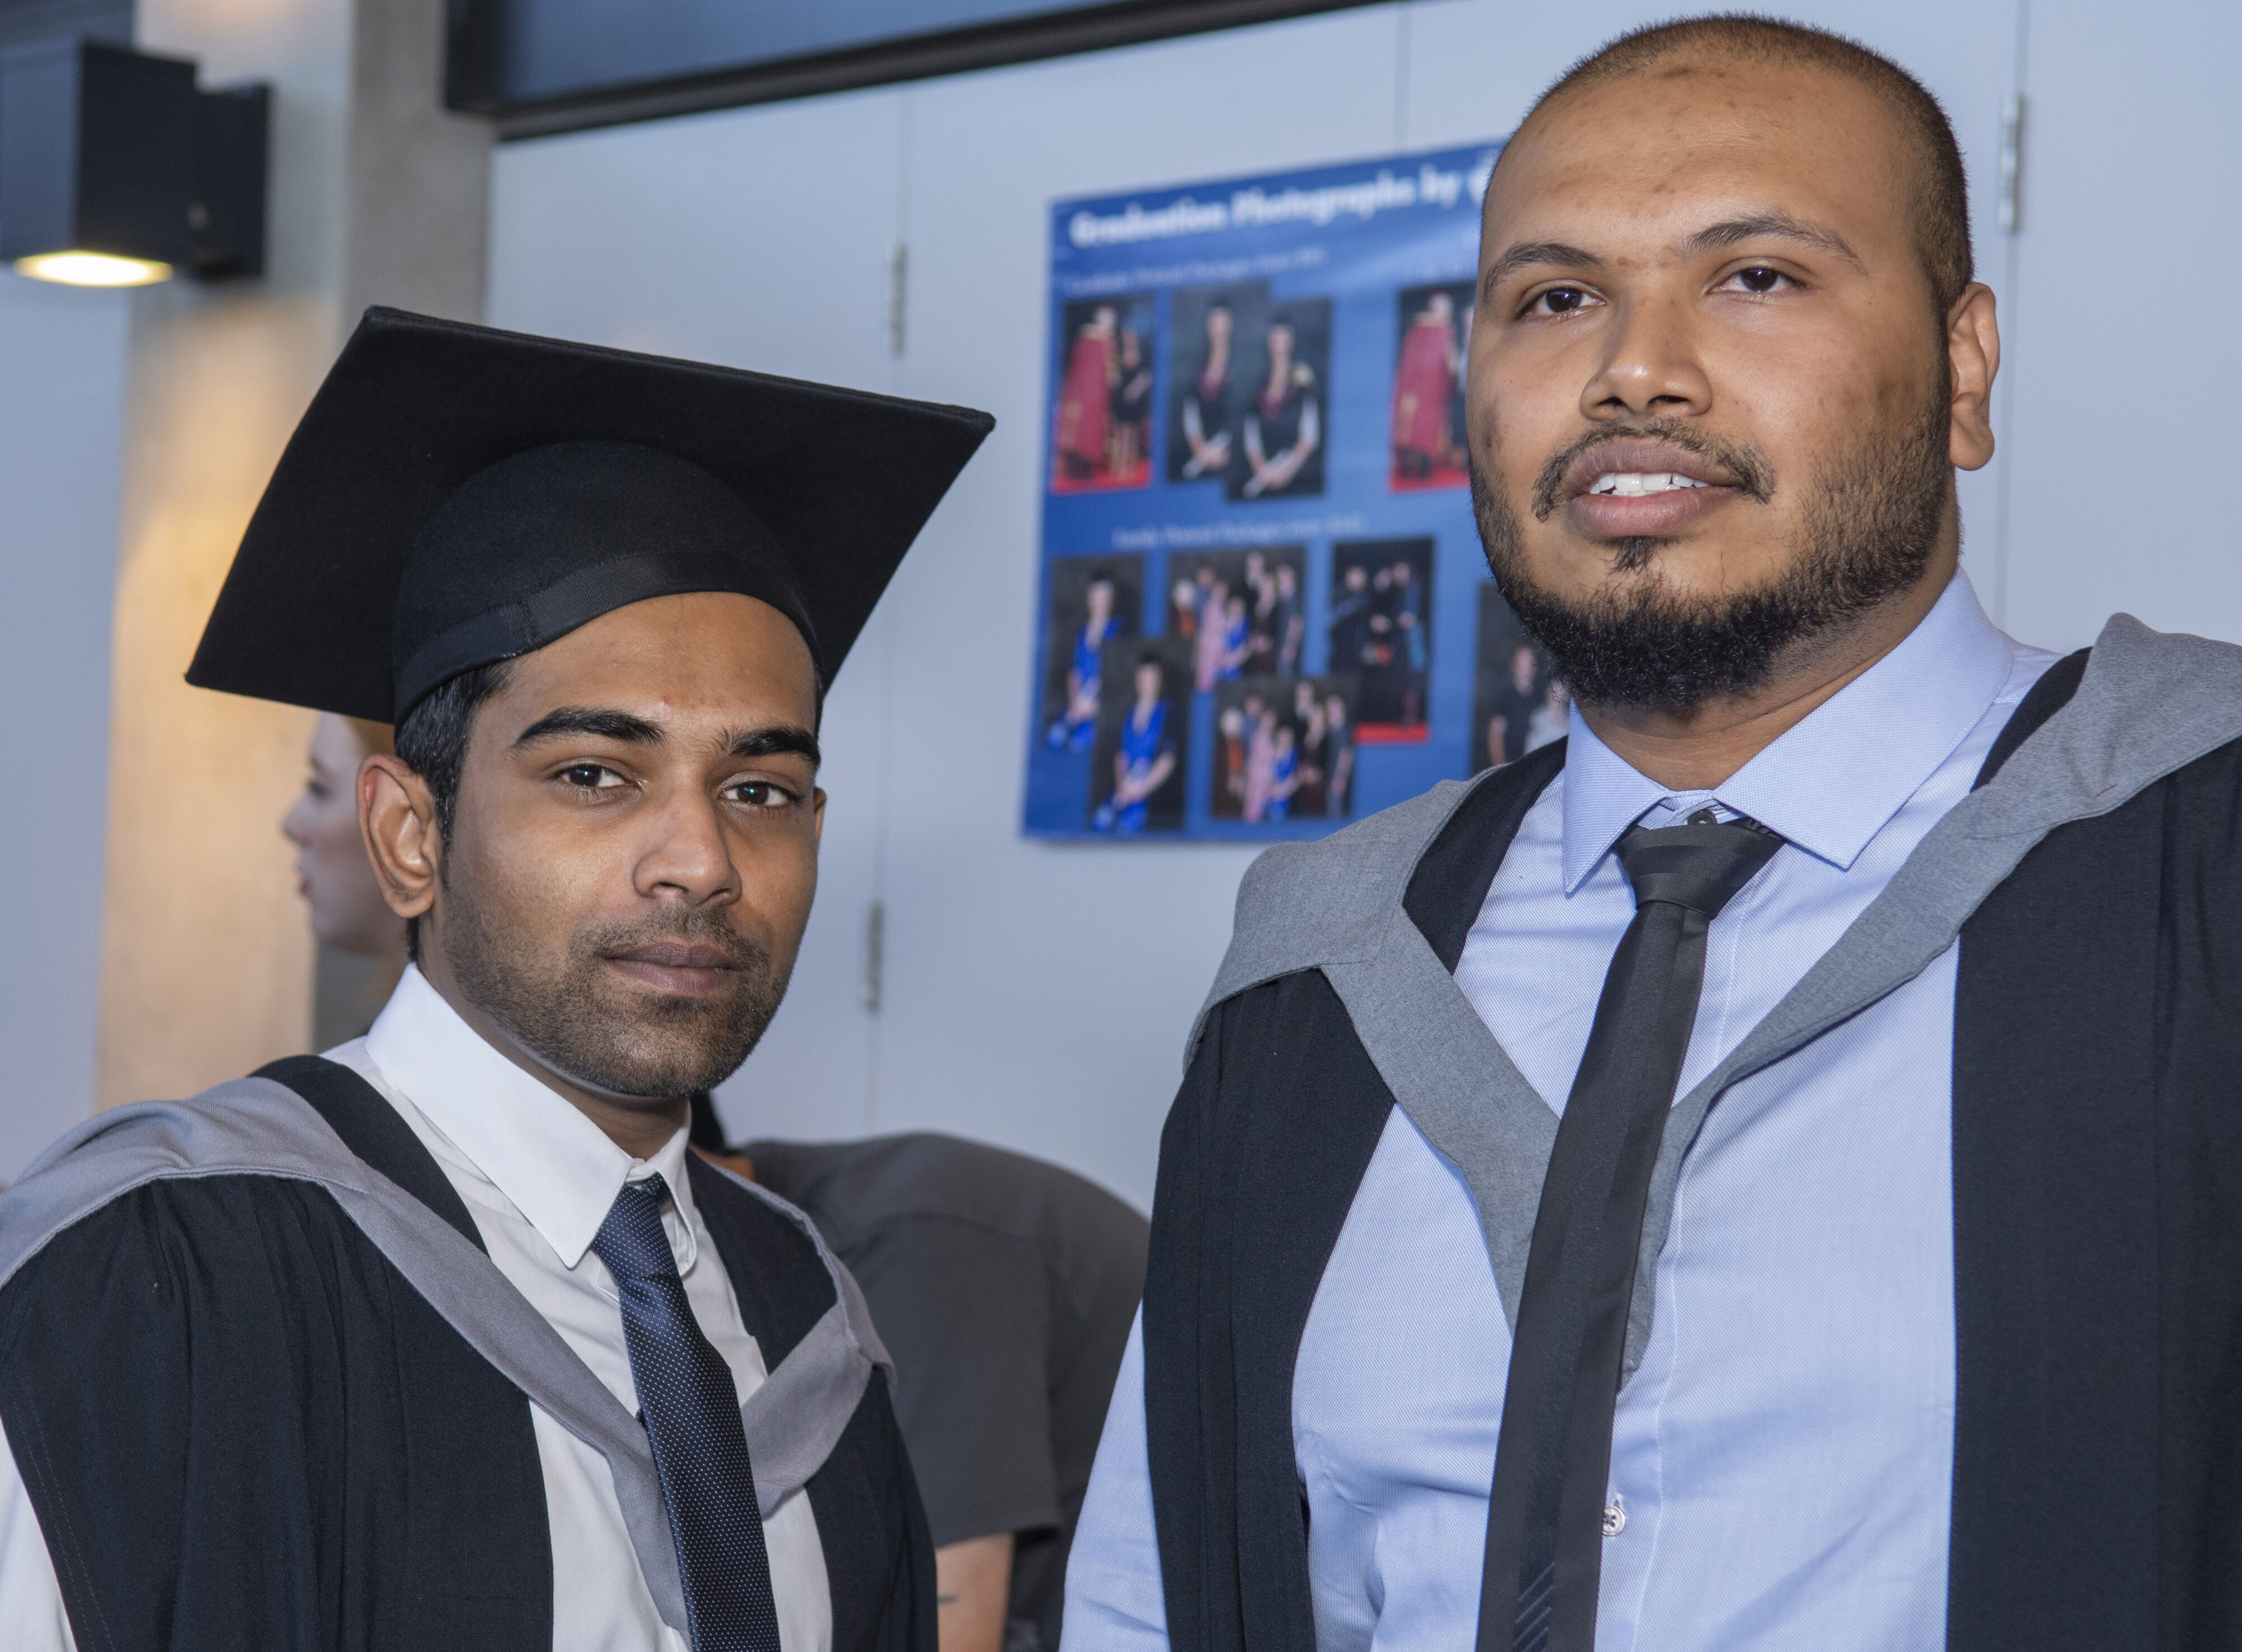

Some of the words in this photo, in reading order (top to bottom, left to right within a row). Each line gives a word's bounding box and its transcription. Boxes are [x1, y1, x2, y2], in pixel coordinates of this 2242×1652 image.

[1070, 196, 1228, 248] Graduation
[1231, 170, 1416, 225] Photographs
[1420, 164, 1462, 210] by
